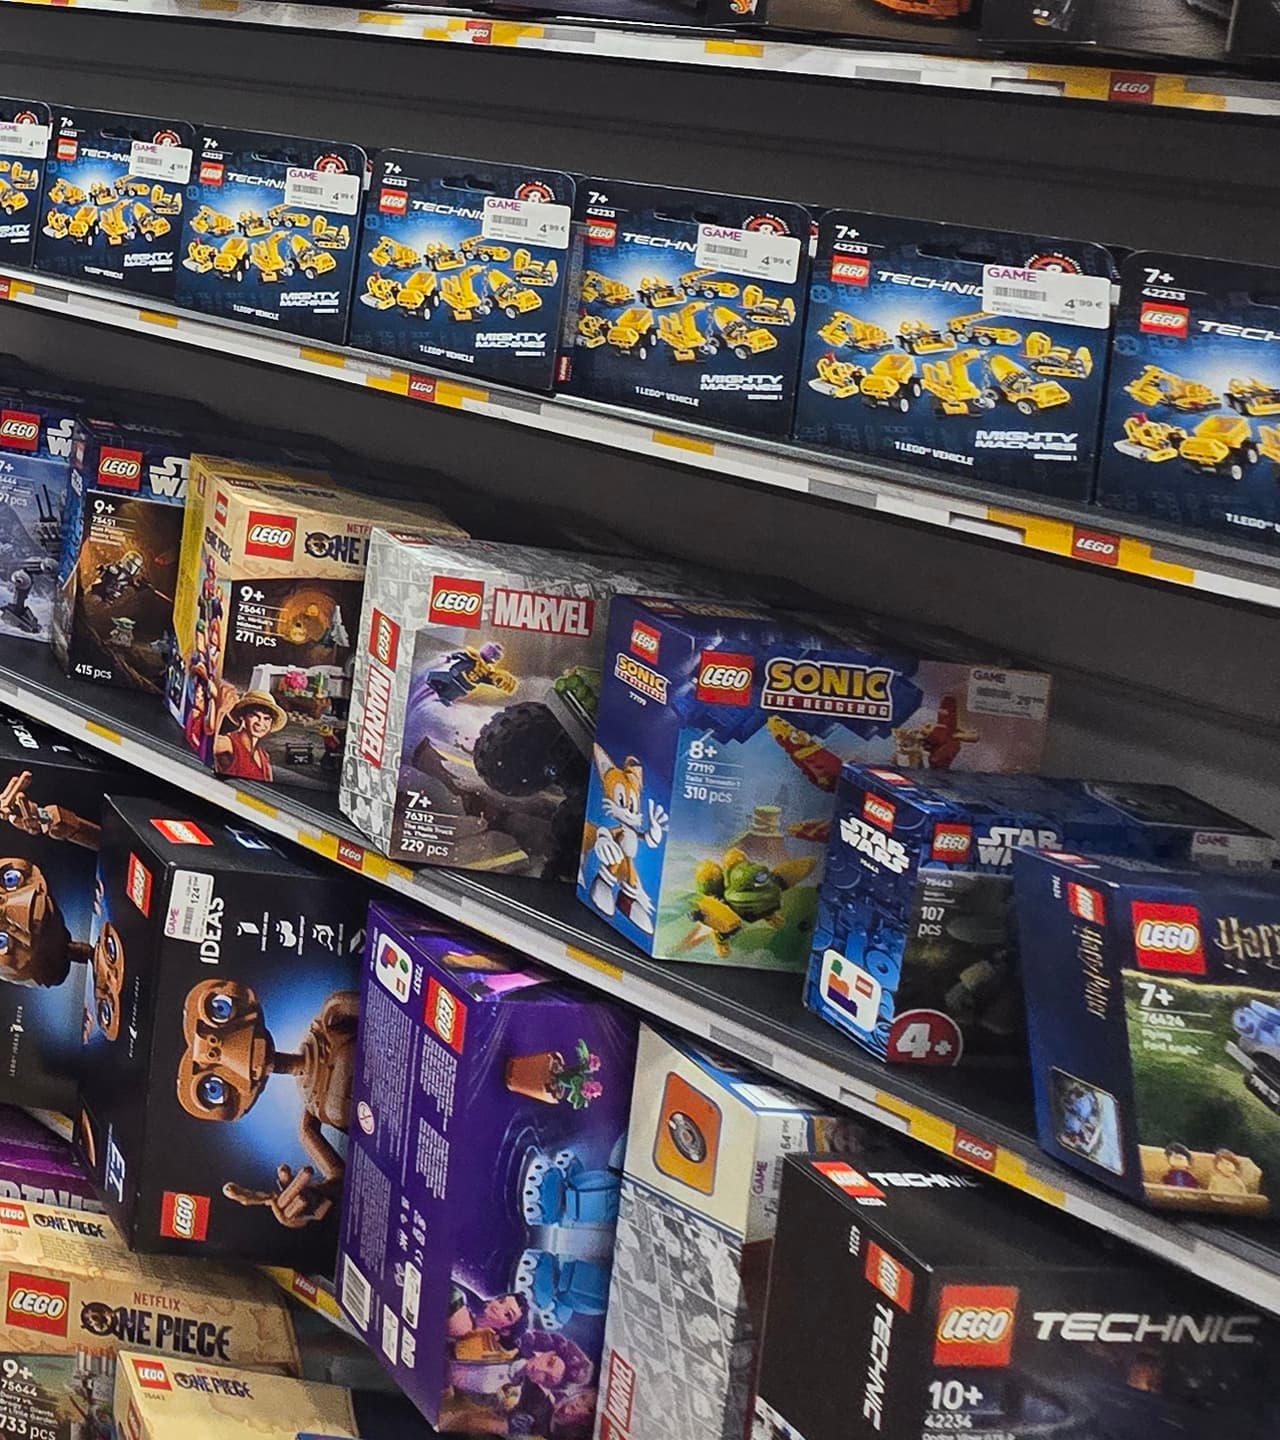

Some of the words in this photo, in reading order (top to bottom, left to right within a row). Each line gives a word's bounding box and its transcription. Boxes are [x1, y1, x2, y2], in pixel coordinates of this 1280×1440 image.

[383, 162, 404, 177] 7+
[486, 198, 522, 213] GAME
[834, 224, 860, 241] 7+
[832, 242, 868, 255] 42233
[986, 267, 1038, 283] GAME
[475, 332, 547, 348] MIGHTY
[975, 429, 1079, 445] MIGHTY
[93, 500, 116, 516] 9+
[240, 586, 265, 603] 9+
[434, 591, 481, 614] LEGO
[493, 591, 591, 637] MARVEL
[699, 665, 751, 689] LEGO
[766, 662, 892, 701] SONIC
[360, 665, 391, 765] MARVEL
[765, 695, 796, 709] THE
[801, 700, 888, 718] HEDGEHOG
[688, 740, 718, 760] 8+
[404, 811, 434, 825] 76312
[840, 816, 907, 860] STAR
[921, 905, 944, 921] 107
[200, 897, 225, 965] IDEAS
[917, 922, 943, 937] pcs
[1137, 981, 1174, 1007] 7+
[895, 1022, 952, 1060] 4+
[133, 1291, 181, 1312] NETFLIX
[939, 1308, 1013, 1342] LEGO
[1033, 1312, 1261, 1344] TECHNIC
[862, 1303, 894, 1431] TECHNIC
[1, 1379, 38, 1397] 75644
[927, 1381, 984, 1411] 10+
[923, 1413, 973, 1429] 42234
